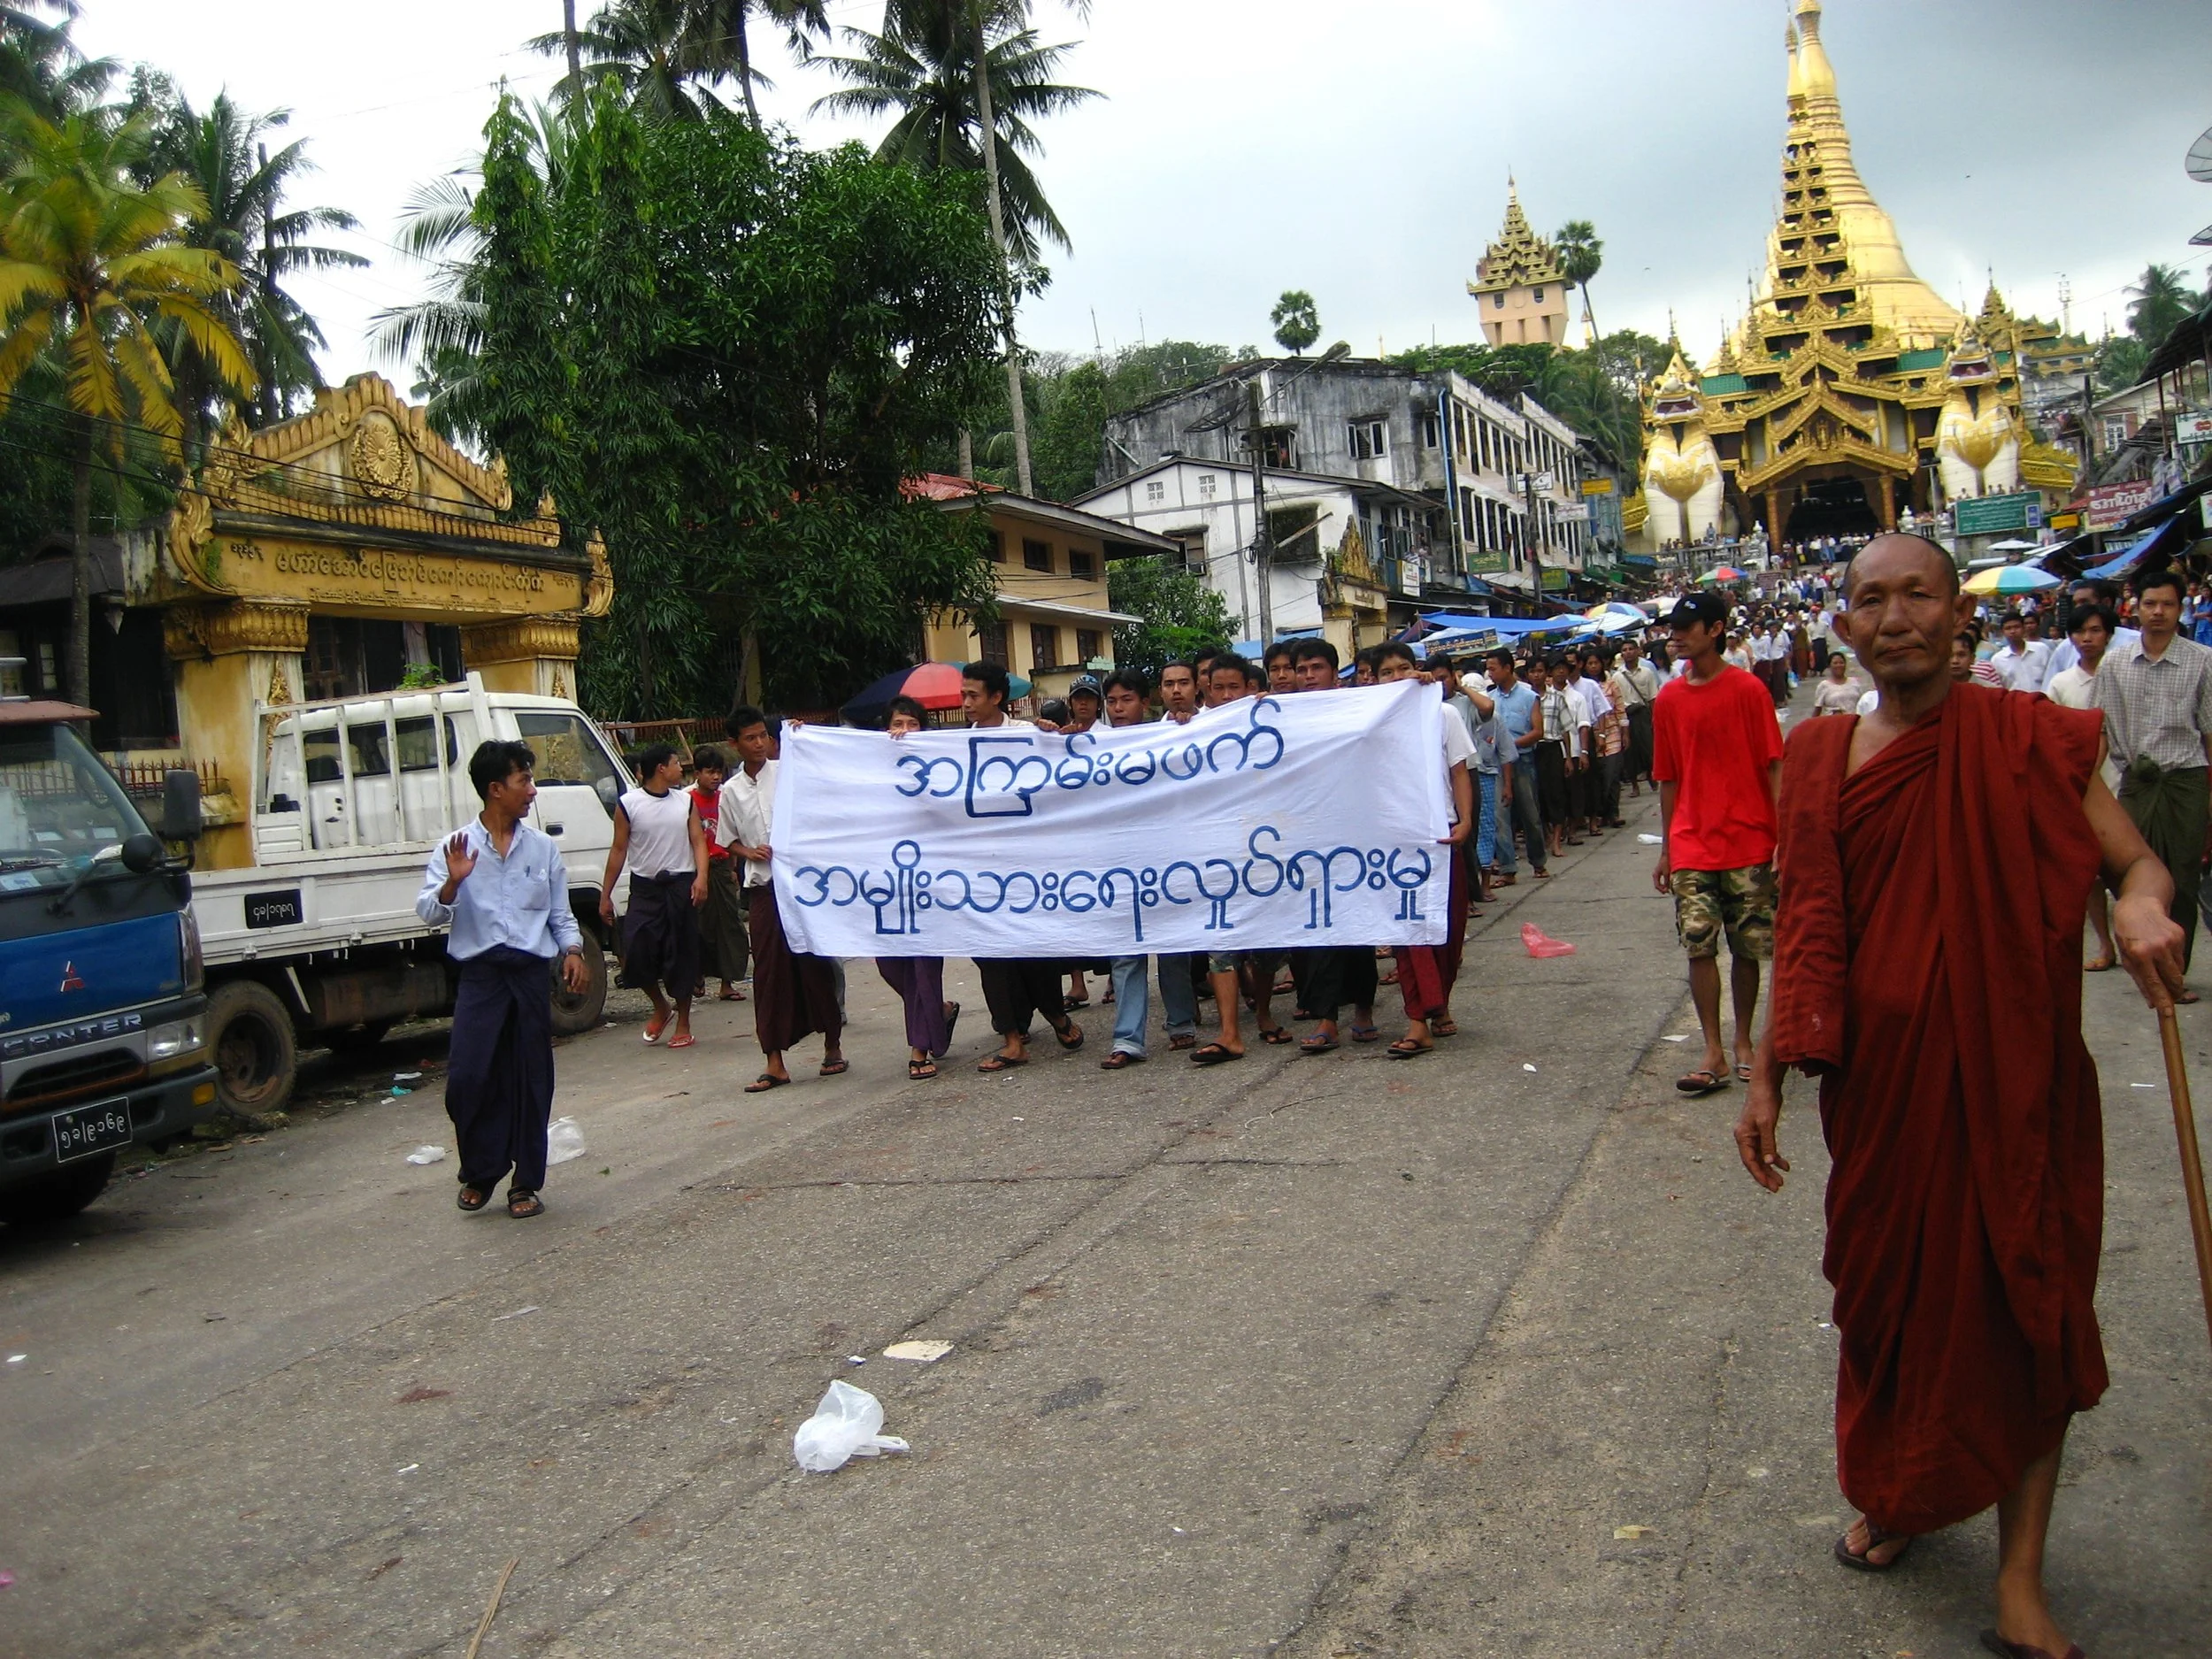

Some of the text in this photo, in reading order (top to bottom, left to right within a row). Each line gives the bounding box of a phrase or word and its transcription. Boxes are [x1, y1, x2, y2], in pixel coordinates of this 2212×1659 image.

[894, 698, 1285, 818] အကြမ်းမဖက်
[794, 825, 1432, 942] အမျိုးသားရေးလှုပ်ရှားမှု
[3, 1013, 142, 1056] CANTER
